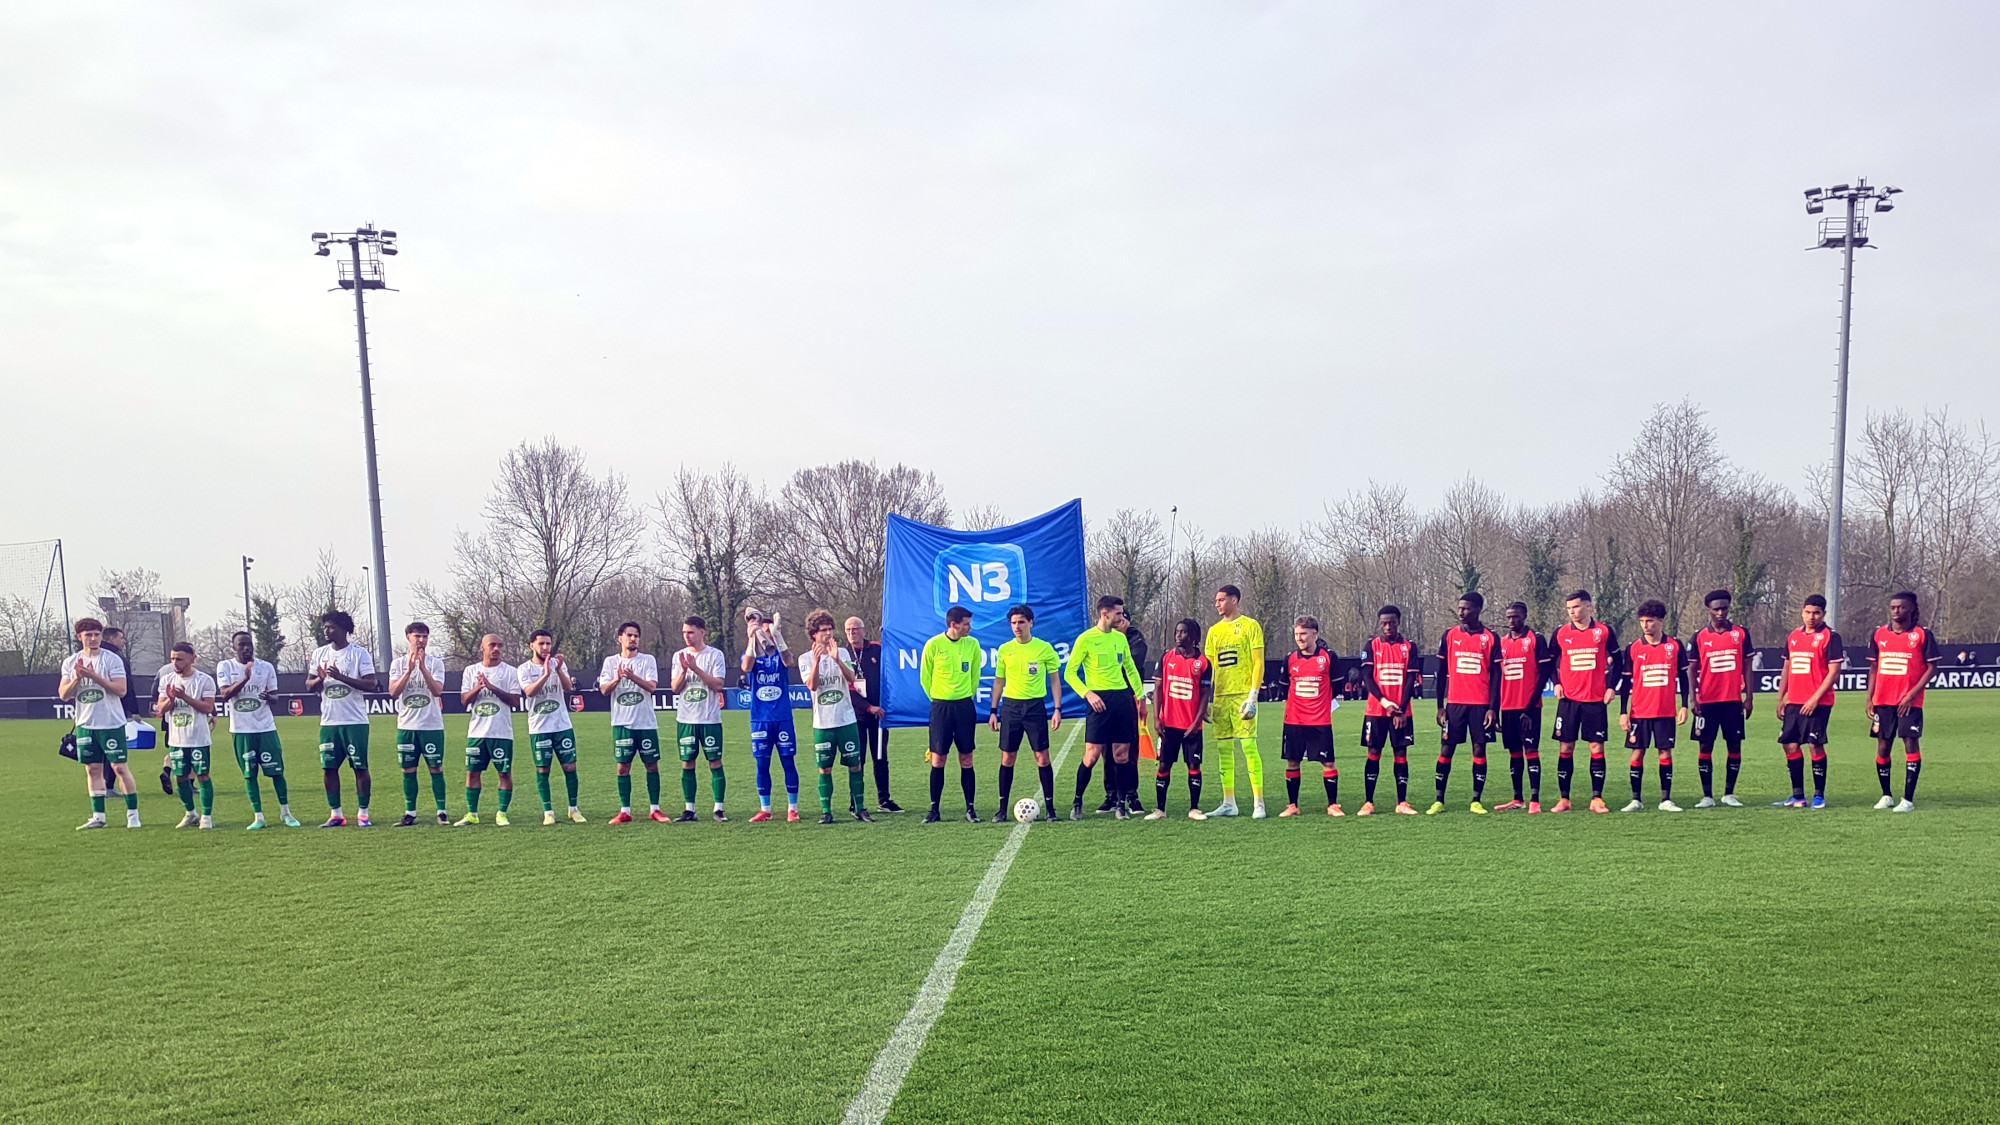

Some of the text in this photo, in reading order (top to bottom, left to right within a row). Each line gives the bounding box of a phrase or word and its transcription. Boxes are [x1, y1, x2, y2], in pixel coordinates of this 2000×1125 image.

[948, 562, 1011, 603] N3
[1366, 721, 1371, 734] 3
[1556, 717, 1562, 729] 6
[1630, 723, 1637, 736] 7
[1695, 717, 1705, 730] 10
